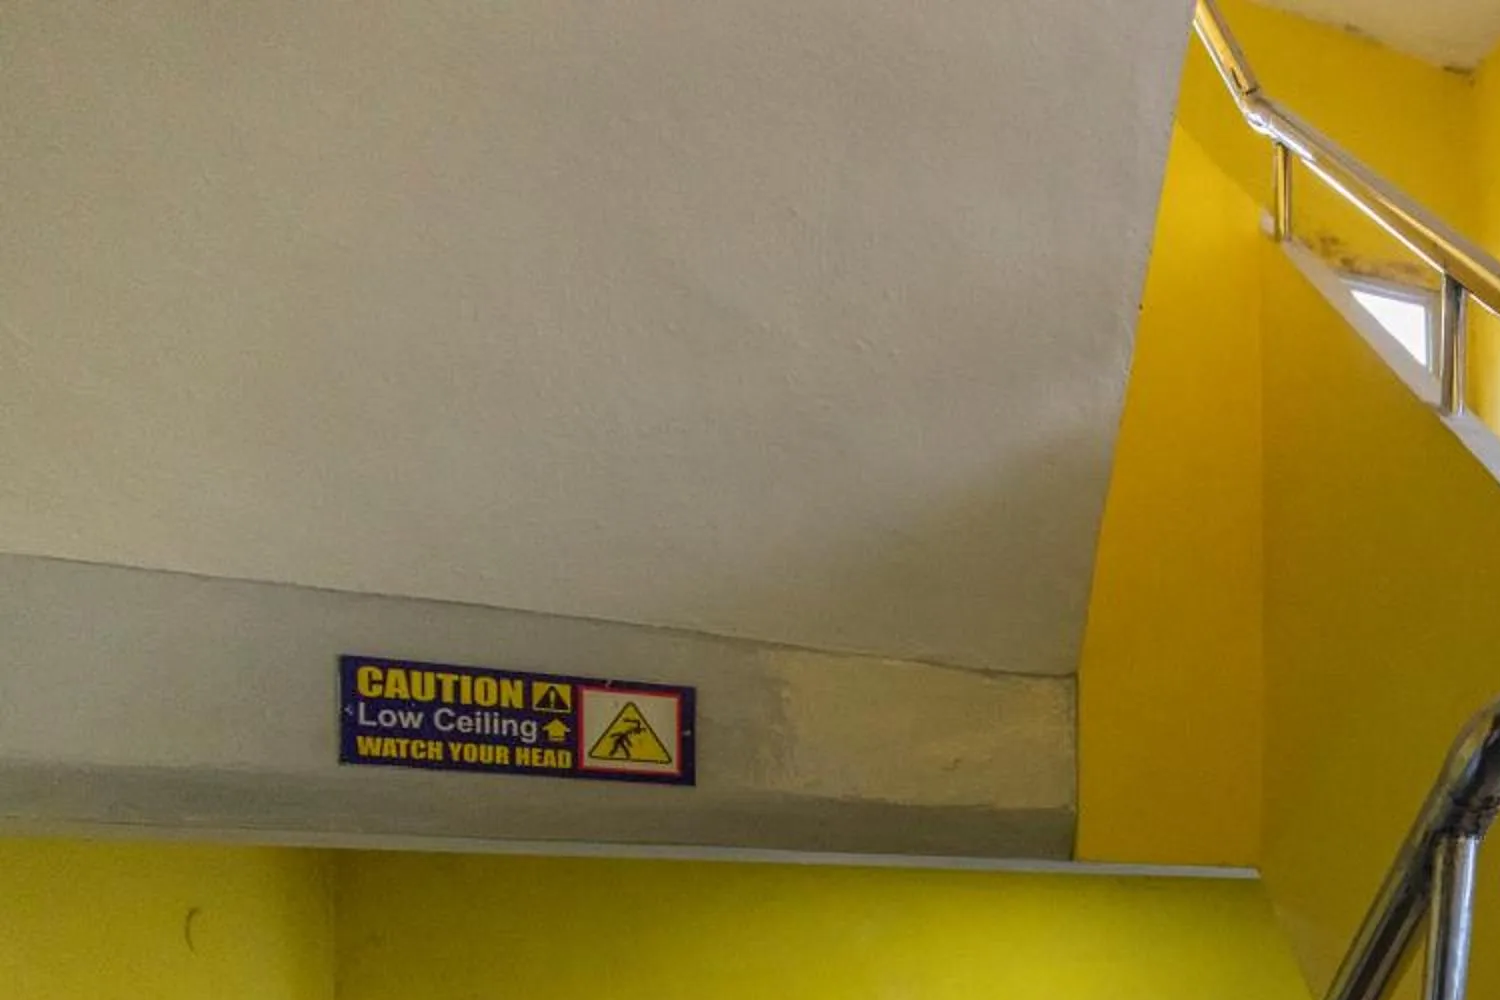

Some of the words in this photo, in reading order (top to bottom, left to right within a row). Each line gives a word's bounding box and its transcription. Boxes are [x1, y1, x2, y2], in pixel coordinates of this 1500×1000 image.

[356, 665, 524, 709] CAUTION
[358, 702, 424, 729] Low
[433, 707, 538, 743] Ceiling
[356, 735, 443, 761] WATCH
[449, 742, 509, 765] YOUR
[515, 747, 572, 769] HEAD
